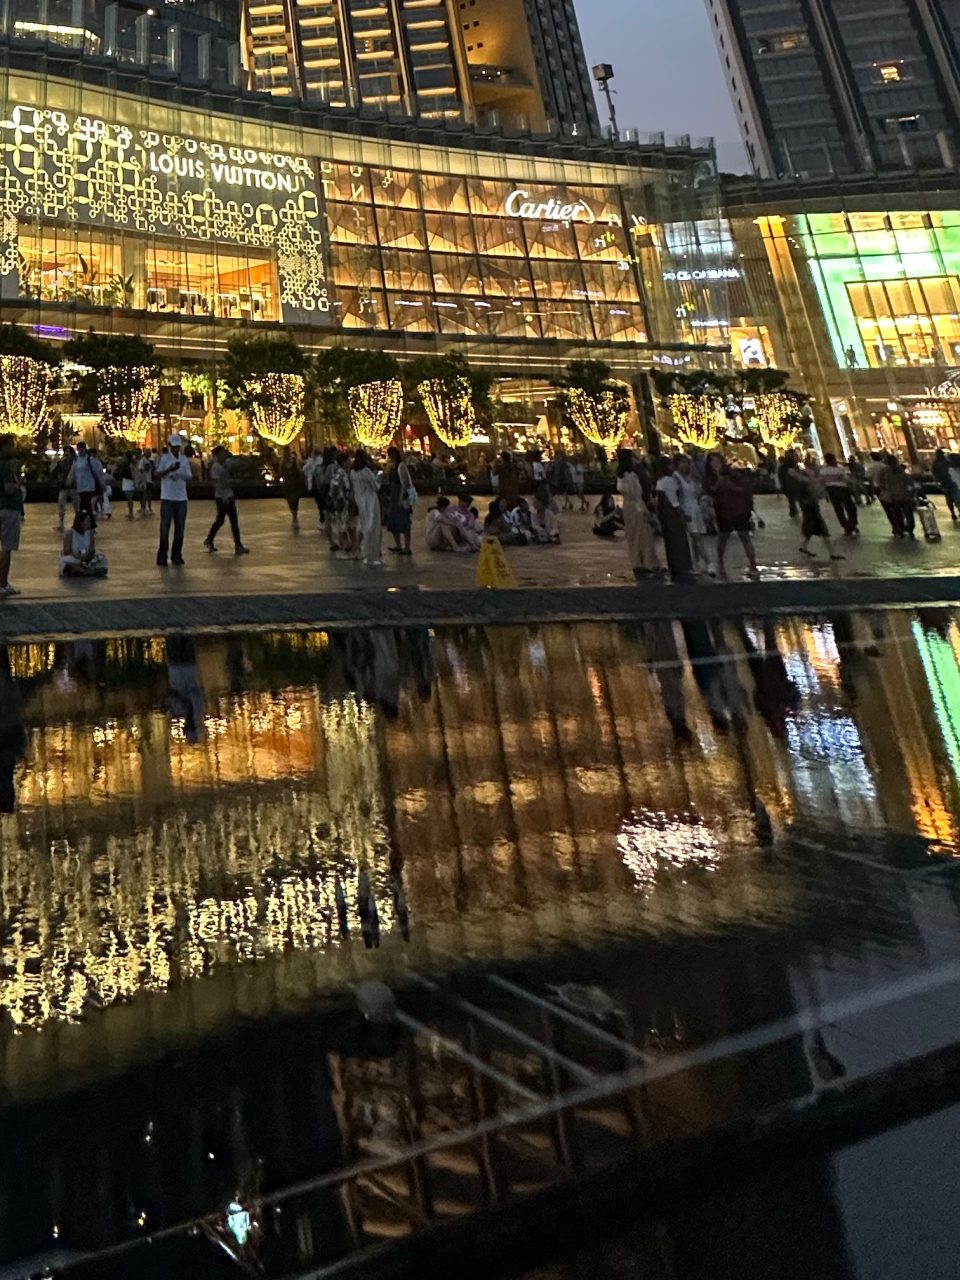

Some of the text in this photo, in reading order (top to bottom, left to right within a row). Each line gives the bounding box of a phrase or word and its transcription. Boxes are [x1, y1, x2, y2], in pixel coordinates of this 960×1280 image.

[149, 151, 292, 193] LOUIS VUITTON
[505, 190, 595, 224] Cartier
